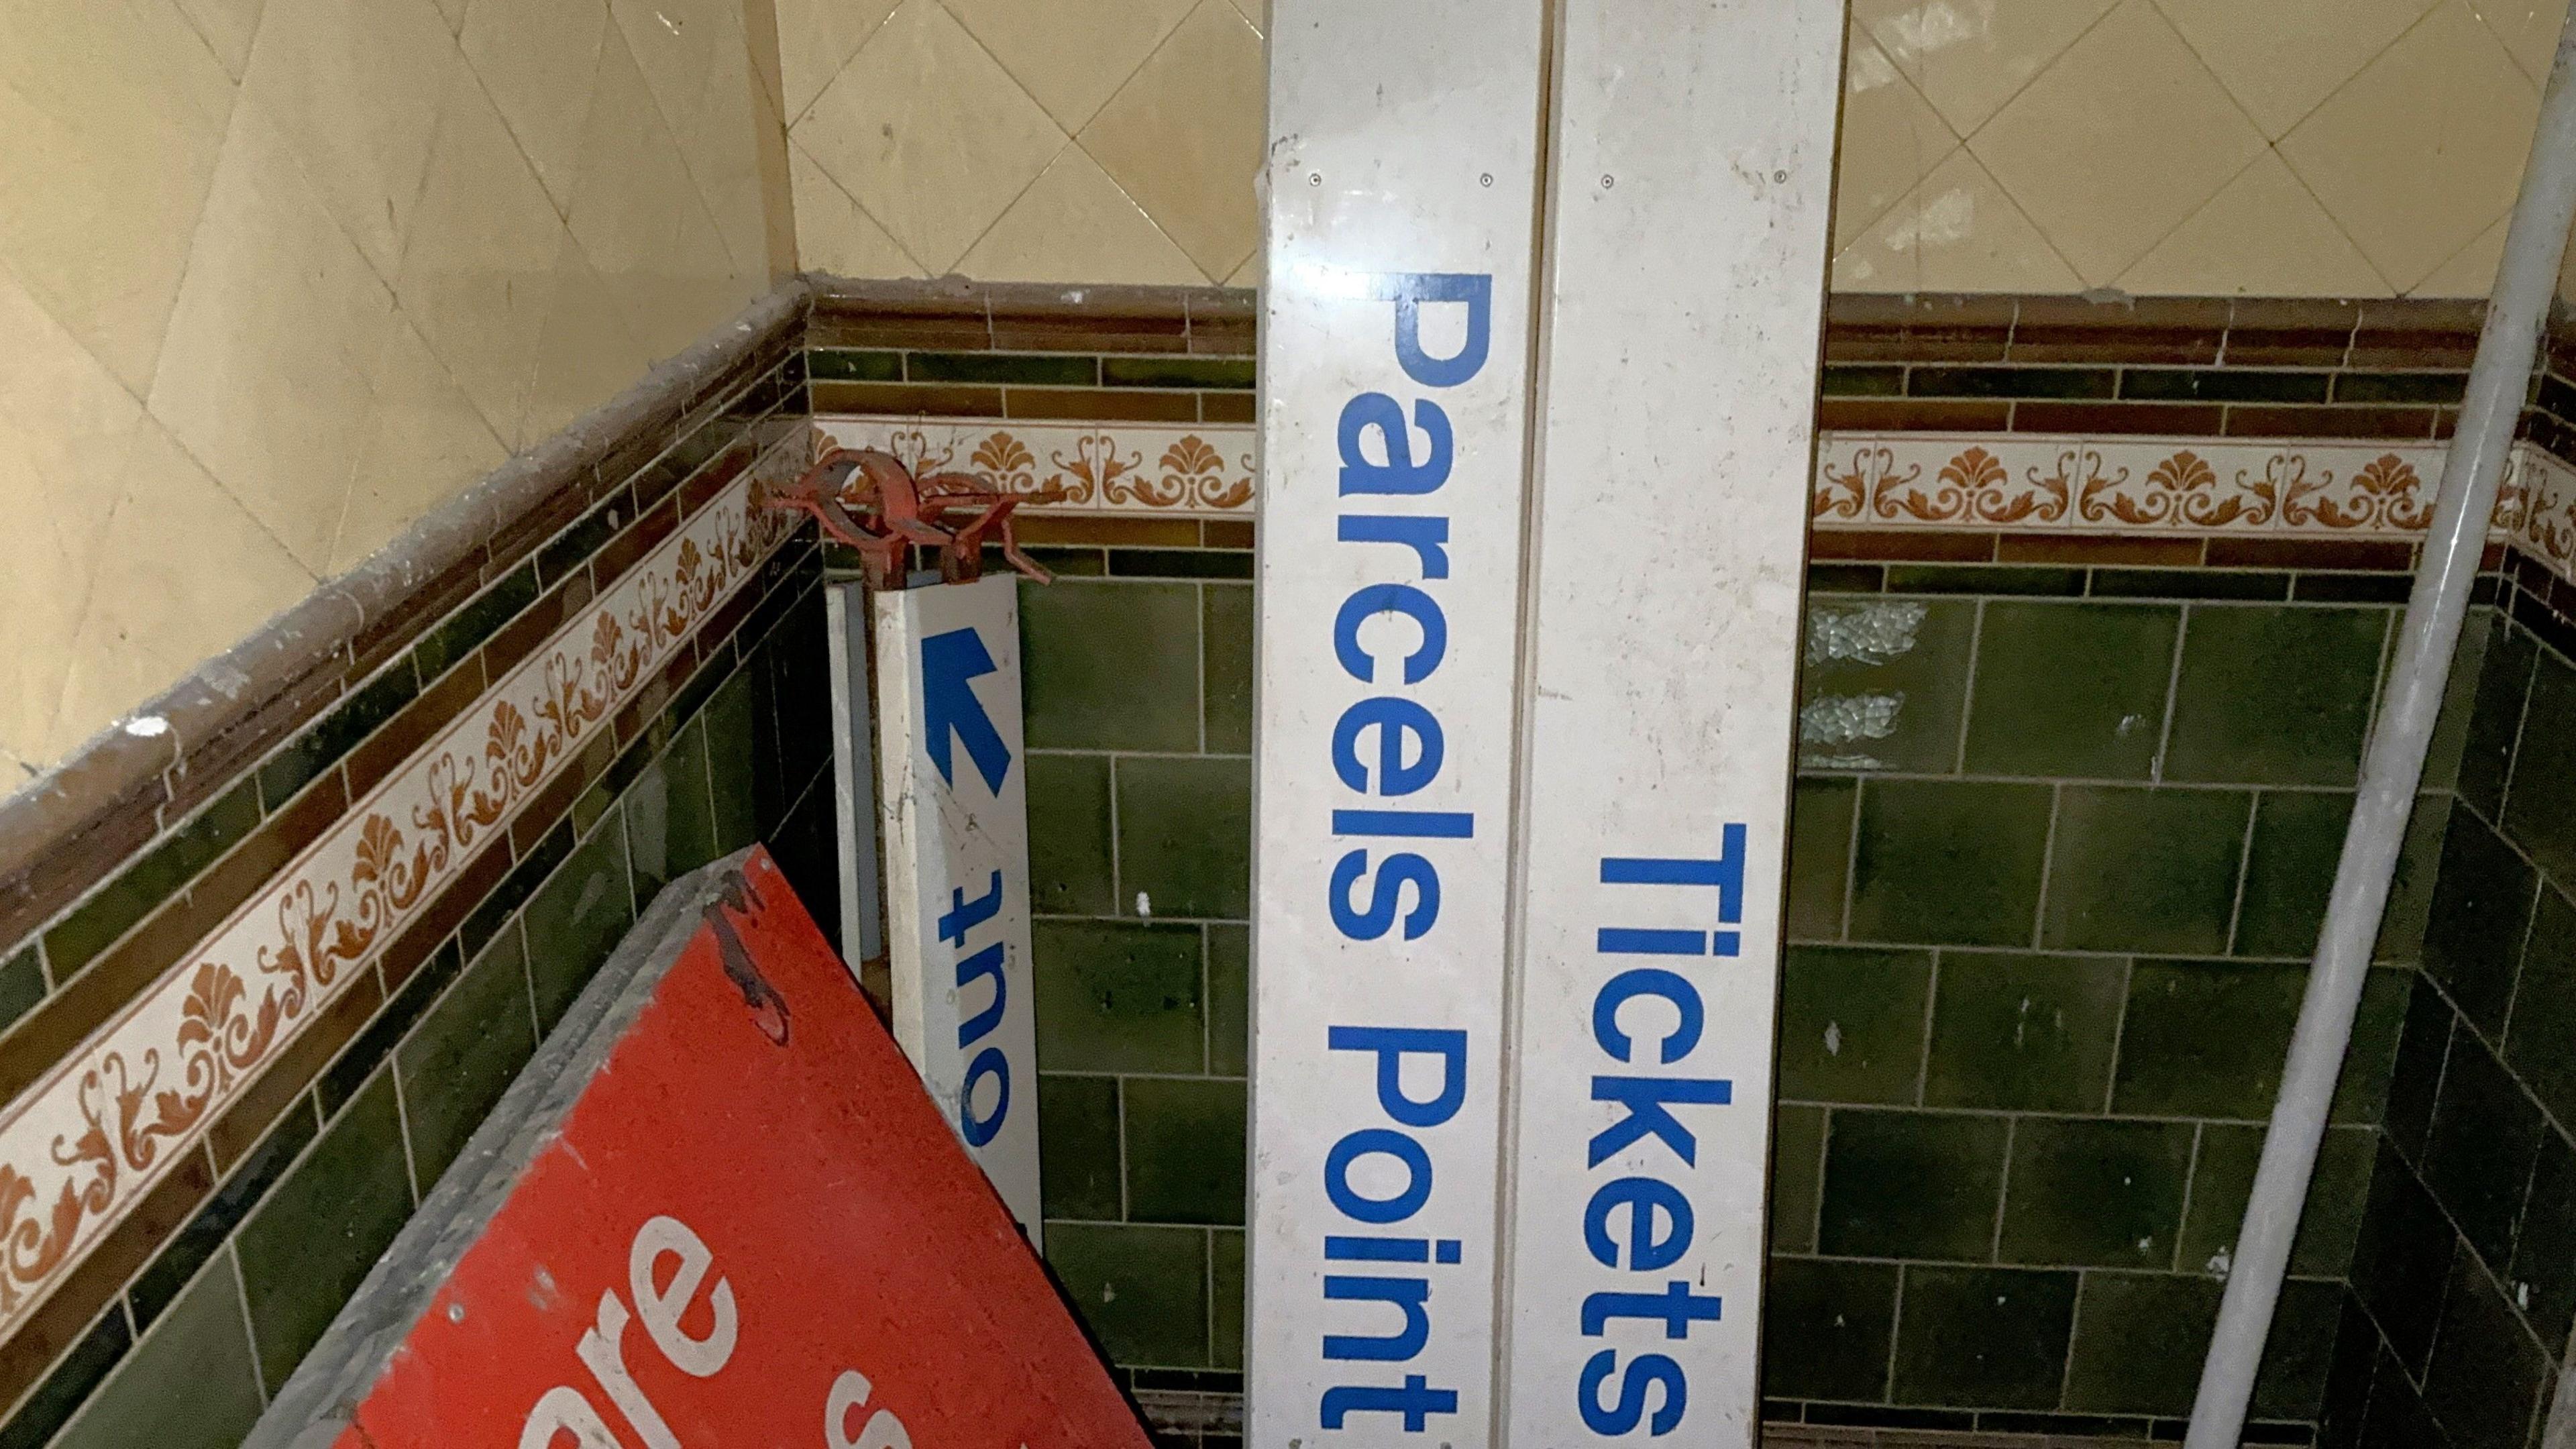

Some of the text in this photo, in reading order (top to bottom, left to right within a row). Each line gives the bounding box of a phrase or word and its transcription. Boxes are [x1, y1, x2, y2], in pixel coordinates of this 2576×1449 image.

[938, 869, 1010, 1147] out
[1320, 272, 1491, 1433] Parcels Point
[518, 1215, 739, 1449] re
[1578, 824, 1747, 1437] Tickets
